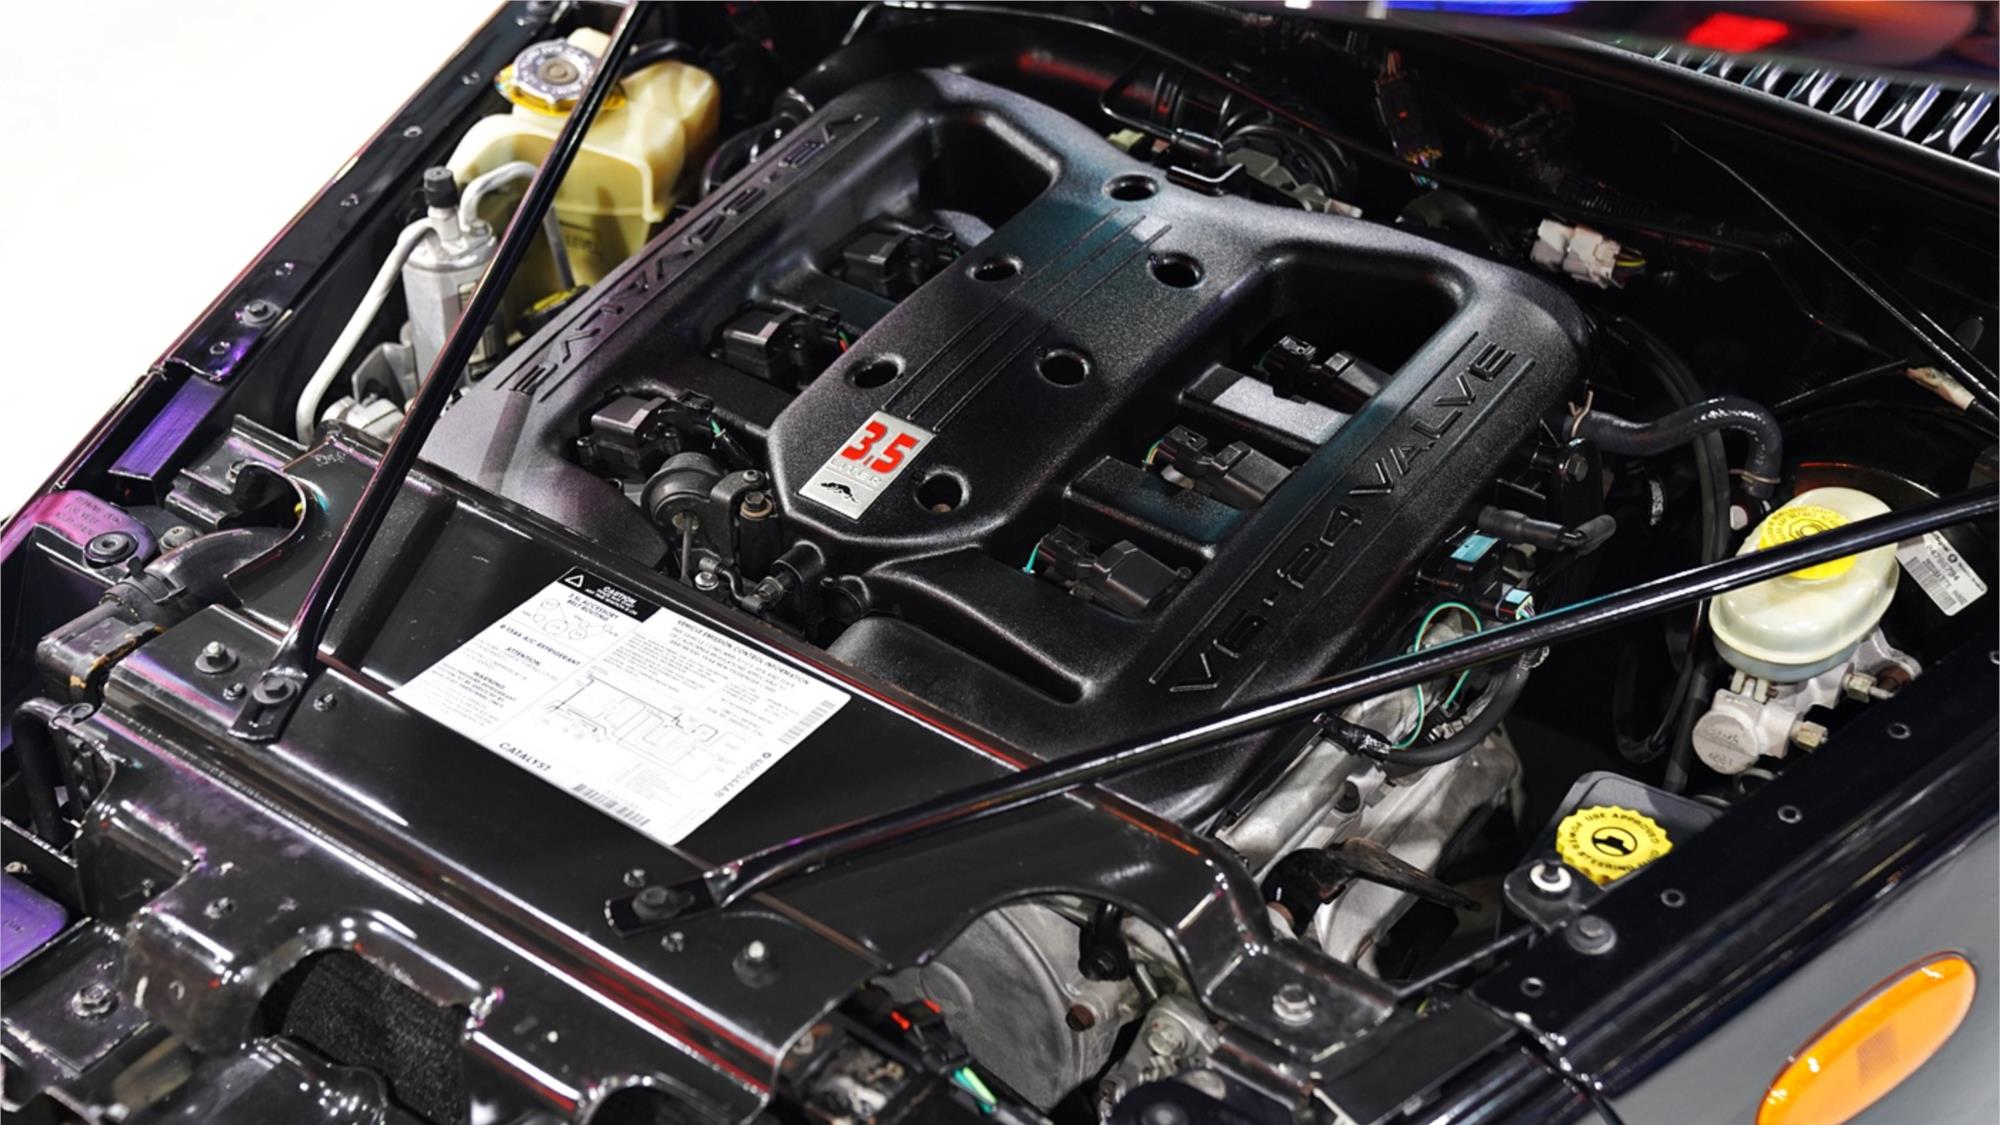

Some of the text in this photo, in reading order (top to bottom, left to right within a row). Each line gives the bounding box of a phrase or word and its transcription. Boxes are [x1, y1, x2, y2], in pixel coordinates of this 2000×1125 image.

[1350, 342, 1516, 495] VALVE
[840, 420, 920, 475] 3.5
[601, 585, 638, 605] CAUTION
[505, 647, 540, 666] ATTENTION
[677, 620, 703, 634] VEHICLE
[702, 631, 733, 649] EMISSION
[733, 647, 763, 664] CONTROL
[764, 661, 809, 685] INFORMATION
[473, 671, 505, 689] WARNING
[499, 743, 551, 771] CATALYST
[1584, 812, 1661, 845] USE APPROVED
